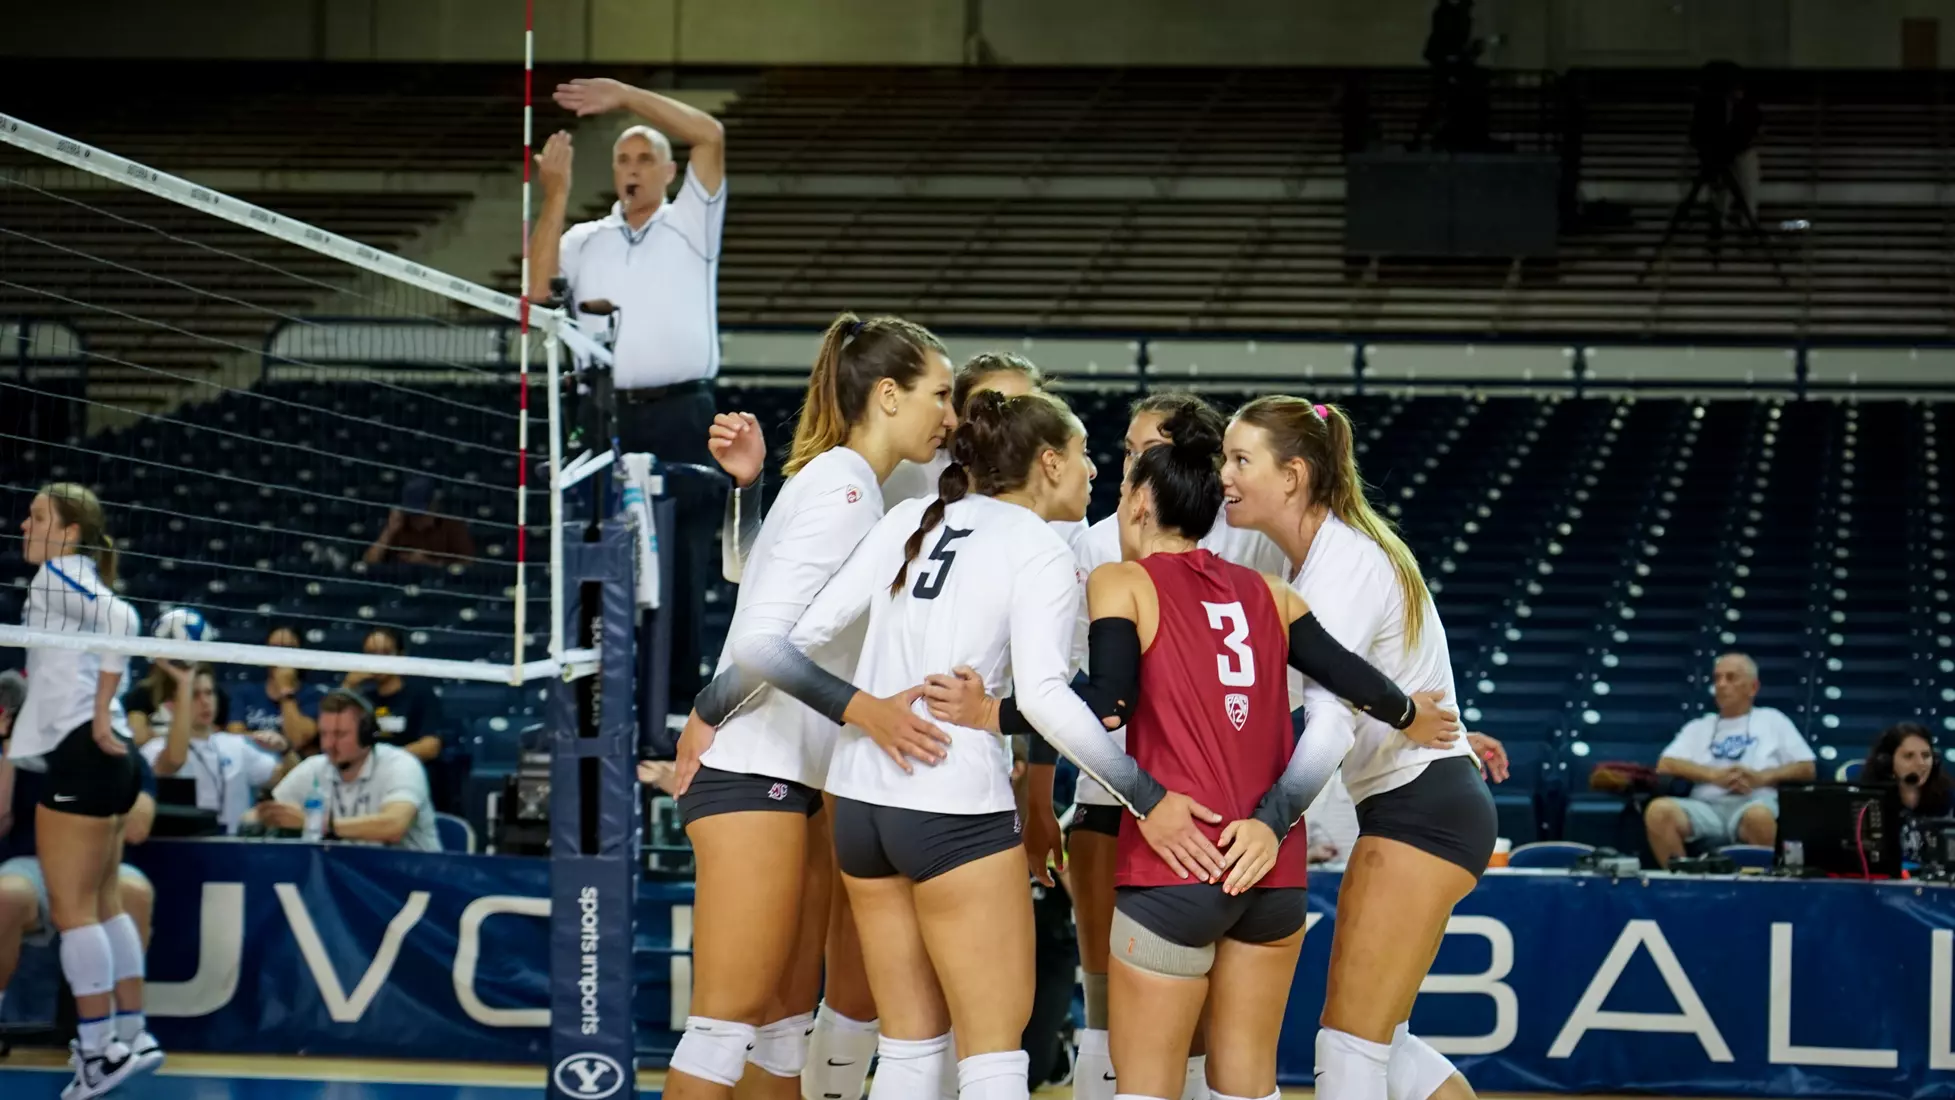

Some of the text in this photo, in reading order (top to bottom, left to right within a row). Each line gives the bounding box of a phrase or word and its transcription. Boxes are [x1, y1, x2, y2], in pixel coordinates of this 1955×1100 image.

[912, 525, 975, 600] 5
[1200, 600, 1256, 687] 3
[577, 886, 602, 1036] sports imports
